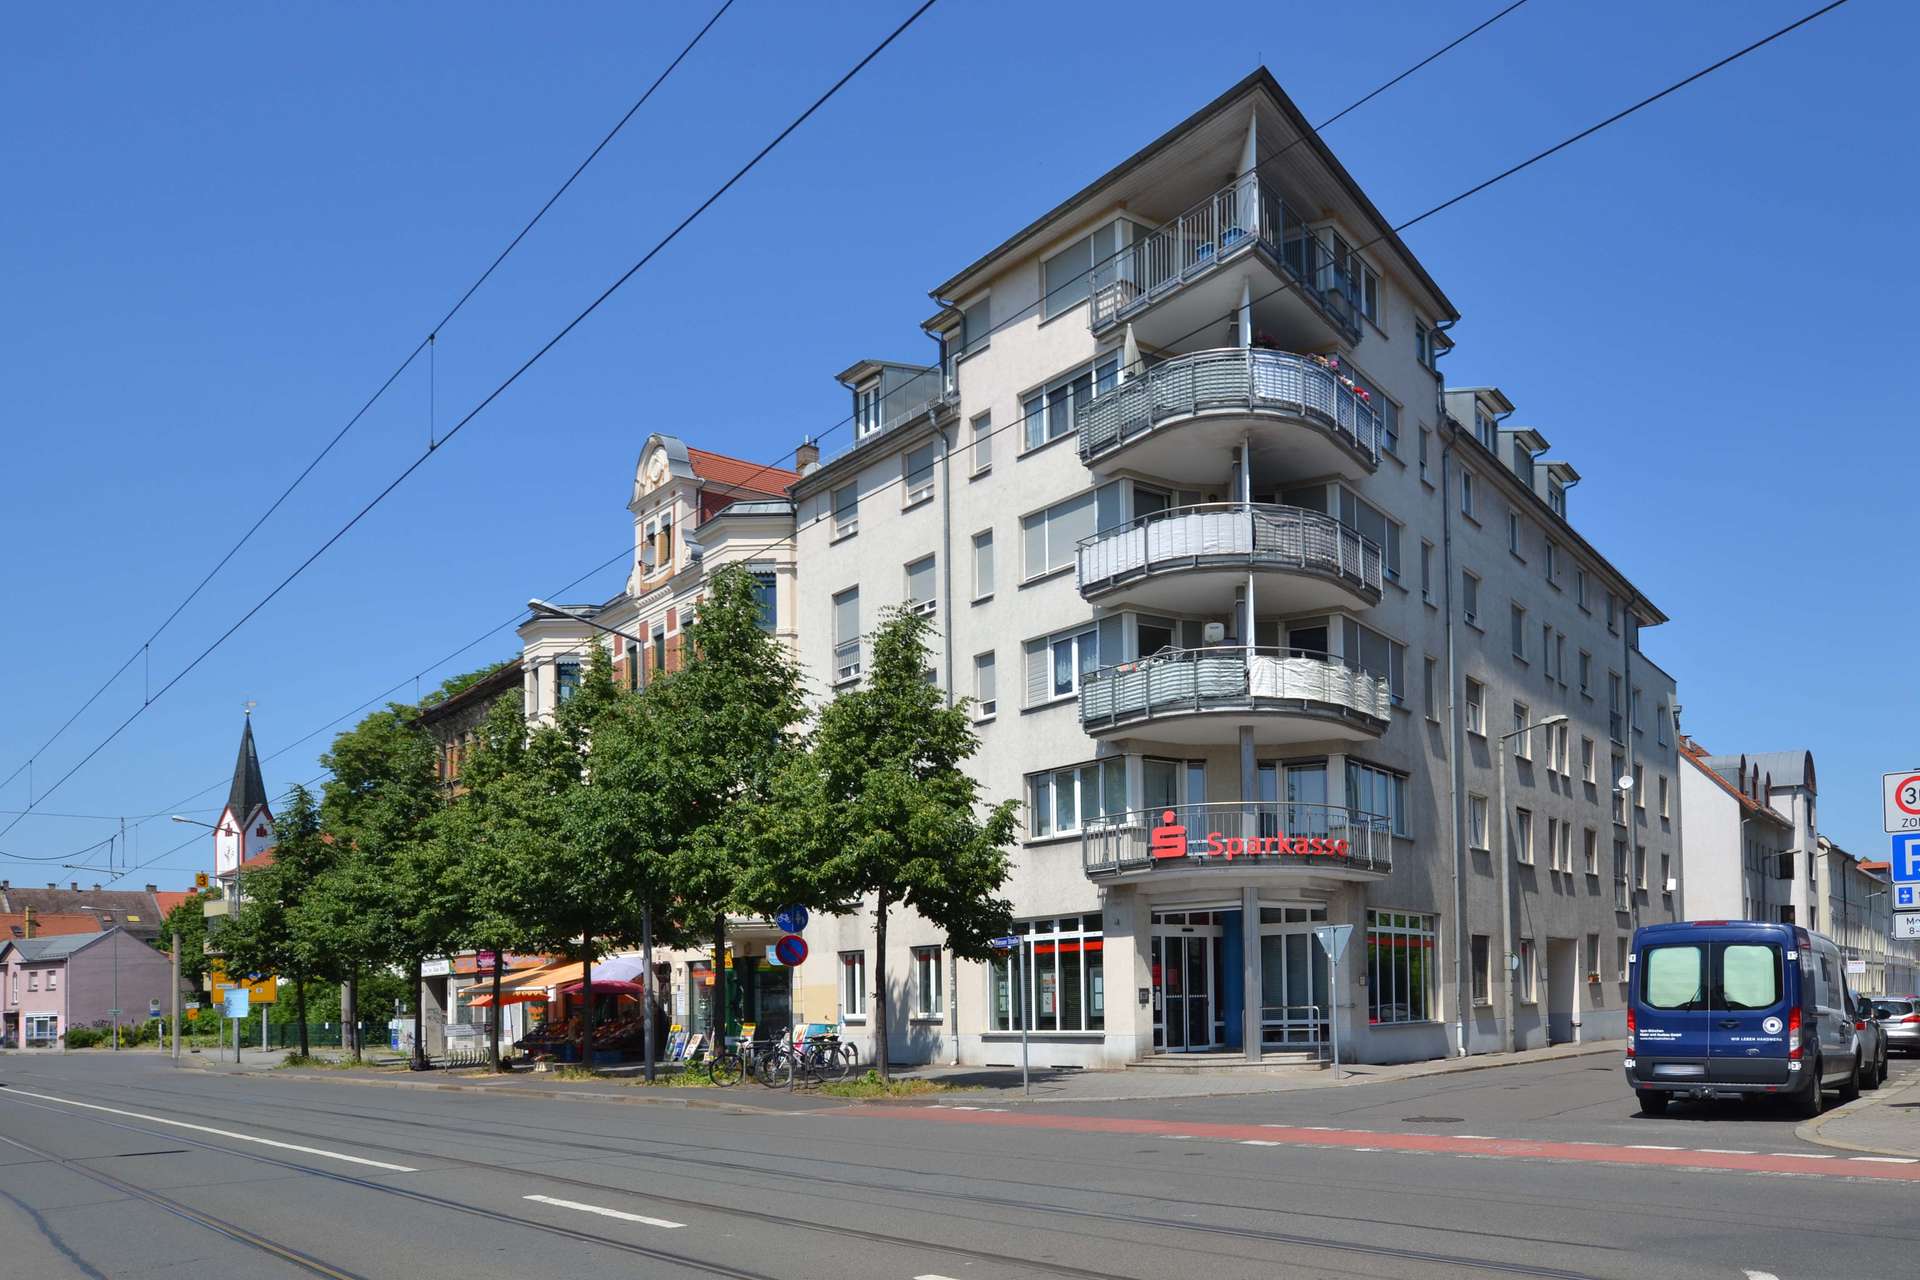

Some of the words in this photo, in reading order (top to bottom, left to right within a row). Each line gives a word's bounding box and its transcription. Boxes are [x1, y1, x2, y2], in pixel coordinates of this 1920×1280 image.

[1905, 787, 1920, 804] 3
[1902, 818, 1920, 828] ZO
[1207, 832, 1349, 860] Sparkasse
